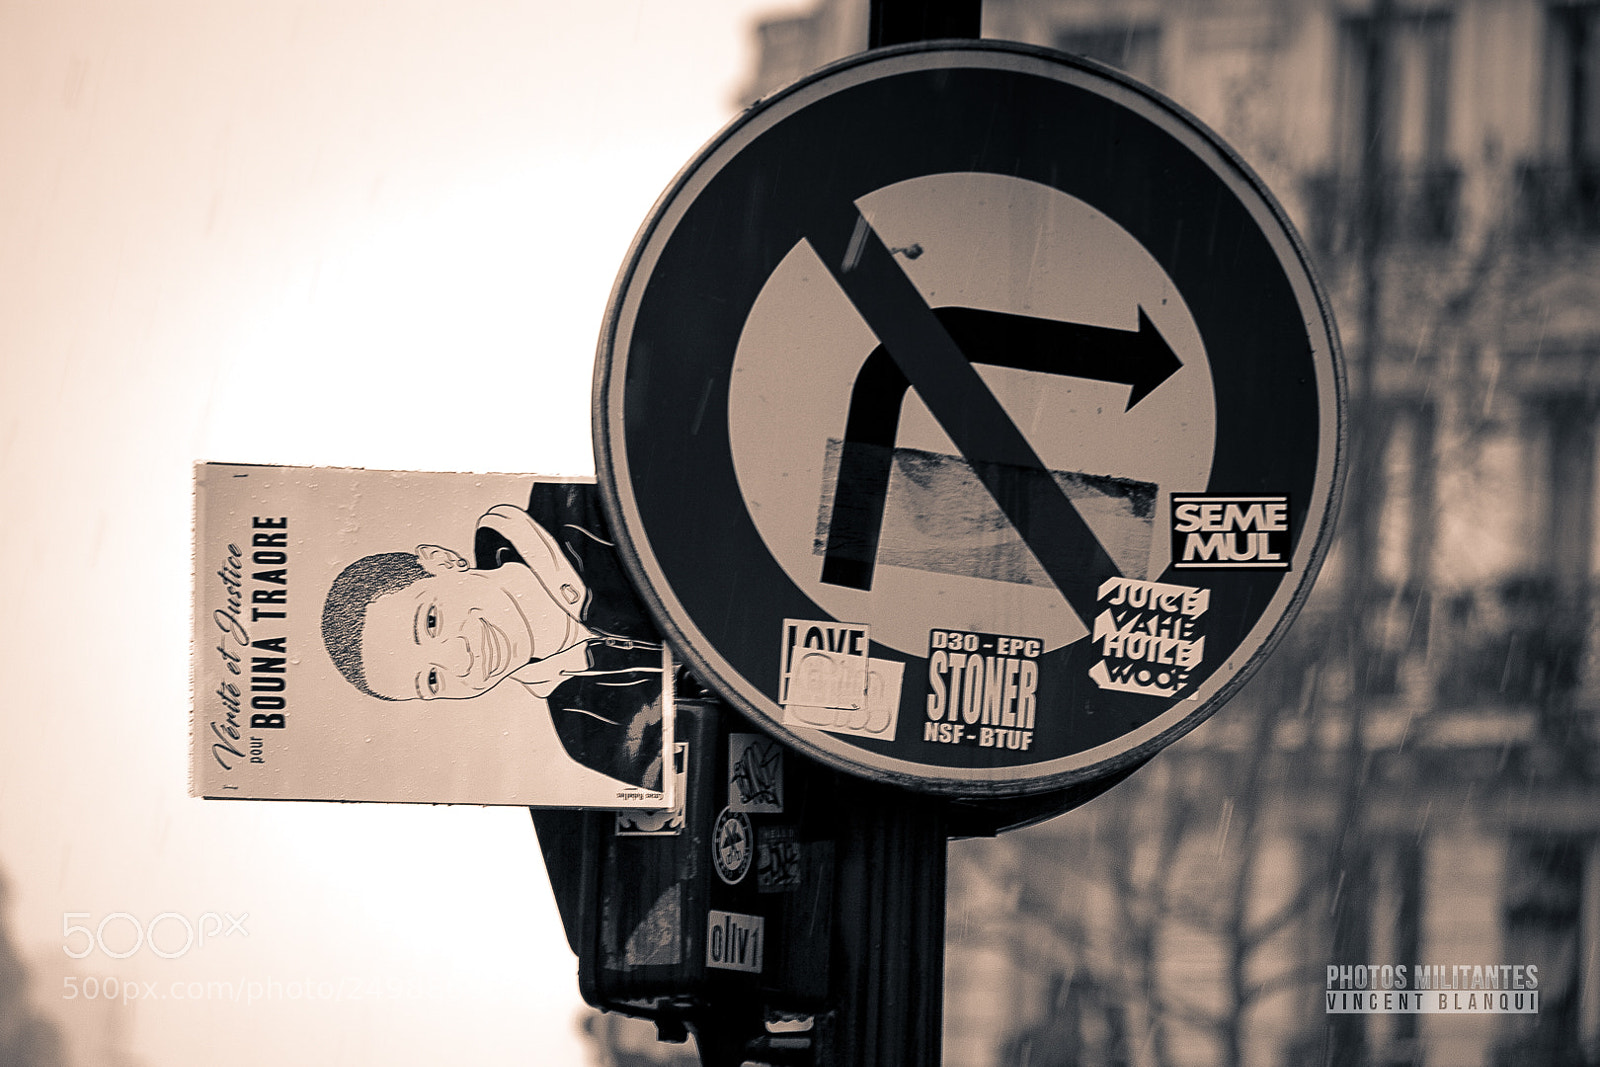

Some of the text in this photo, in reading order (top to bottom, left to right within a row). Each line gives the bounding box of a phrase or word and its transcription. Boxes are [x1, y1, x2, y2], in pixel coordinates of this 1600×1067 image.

[1174, 503, 1288, 532] SEME
[1182, 532, 1281, 561] MUL
[213, 543, 250, 646] Justice
[1106, 579, 1206, 617] JUICE
[216, 634, 242, 676] et
[249, 516, 288, 764] pour BOUNA TRAORE
[926, 650, 1039, 729] STONER
